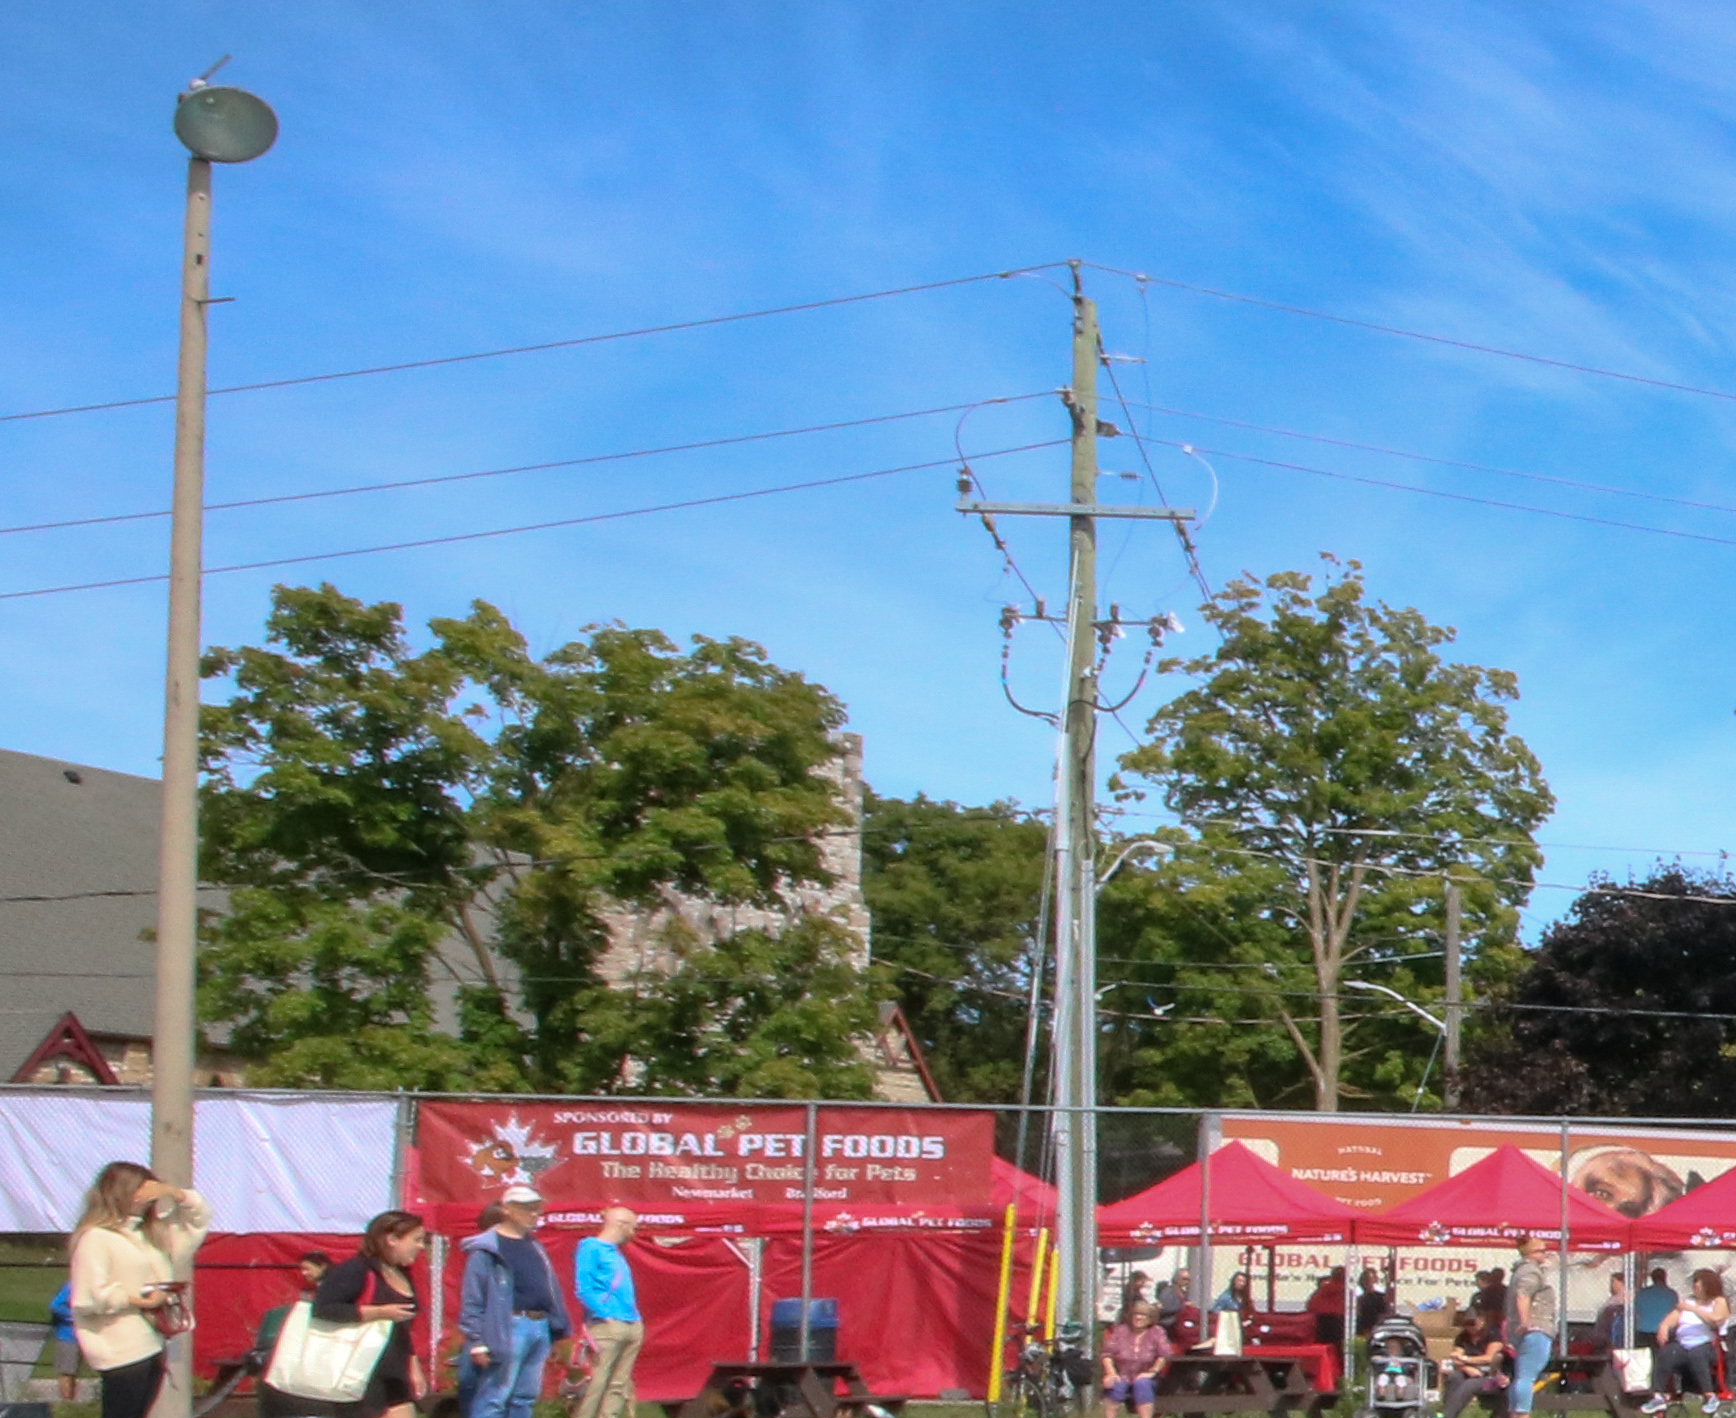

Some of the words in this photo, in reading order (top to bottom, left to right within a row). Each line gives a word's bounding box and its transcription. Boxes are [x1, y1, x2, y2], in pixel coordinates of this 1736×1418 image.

[552, 1110, 650, 1124] SPONSORED
[652, 1112, 674, 1124] BY
[572, 1130, 726, 1157] GLOBAL
[737, 1132, 808, 1158] PET
[821, 1133, 945, 1160] FOODS
[600, 1160, 642, 1179] The
[648, 1160, 740, 1185] Healthy
[824, 1162, 860, 1181] for
[865, 1163, 918, 1182] Pets
[1291, 1166, 1358, 1183] NATURE'S
[671, 1186, 754, 1199] Newmarket
[547, 1212, 603, 1224] GLOBAL
[862, 1216, 915, 1227] GLOBAL
[919, 1217, 943, 1228] PET
[947, 1217, 993, 1229] FOODS
[1451, 1226, 1500, 1238] GLOBAL
[1400, 1256, 1479, 1273] FOODS
